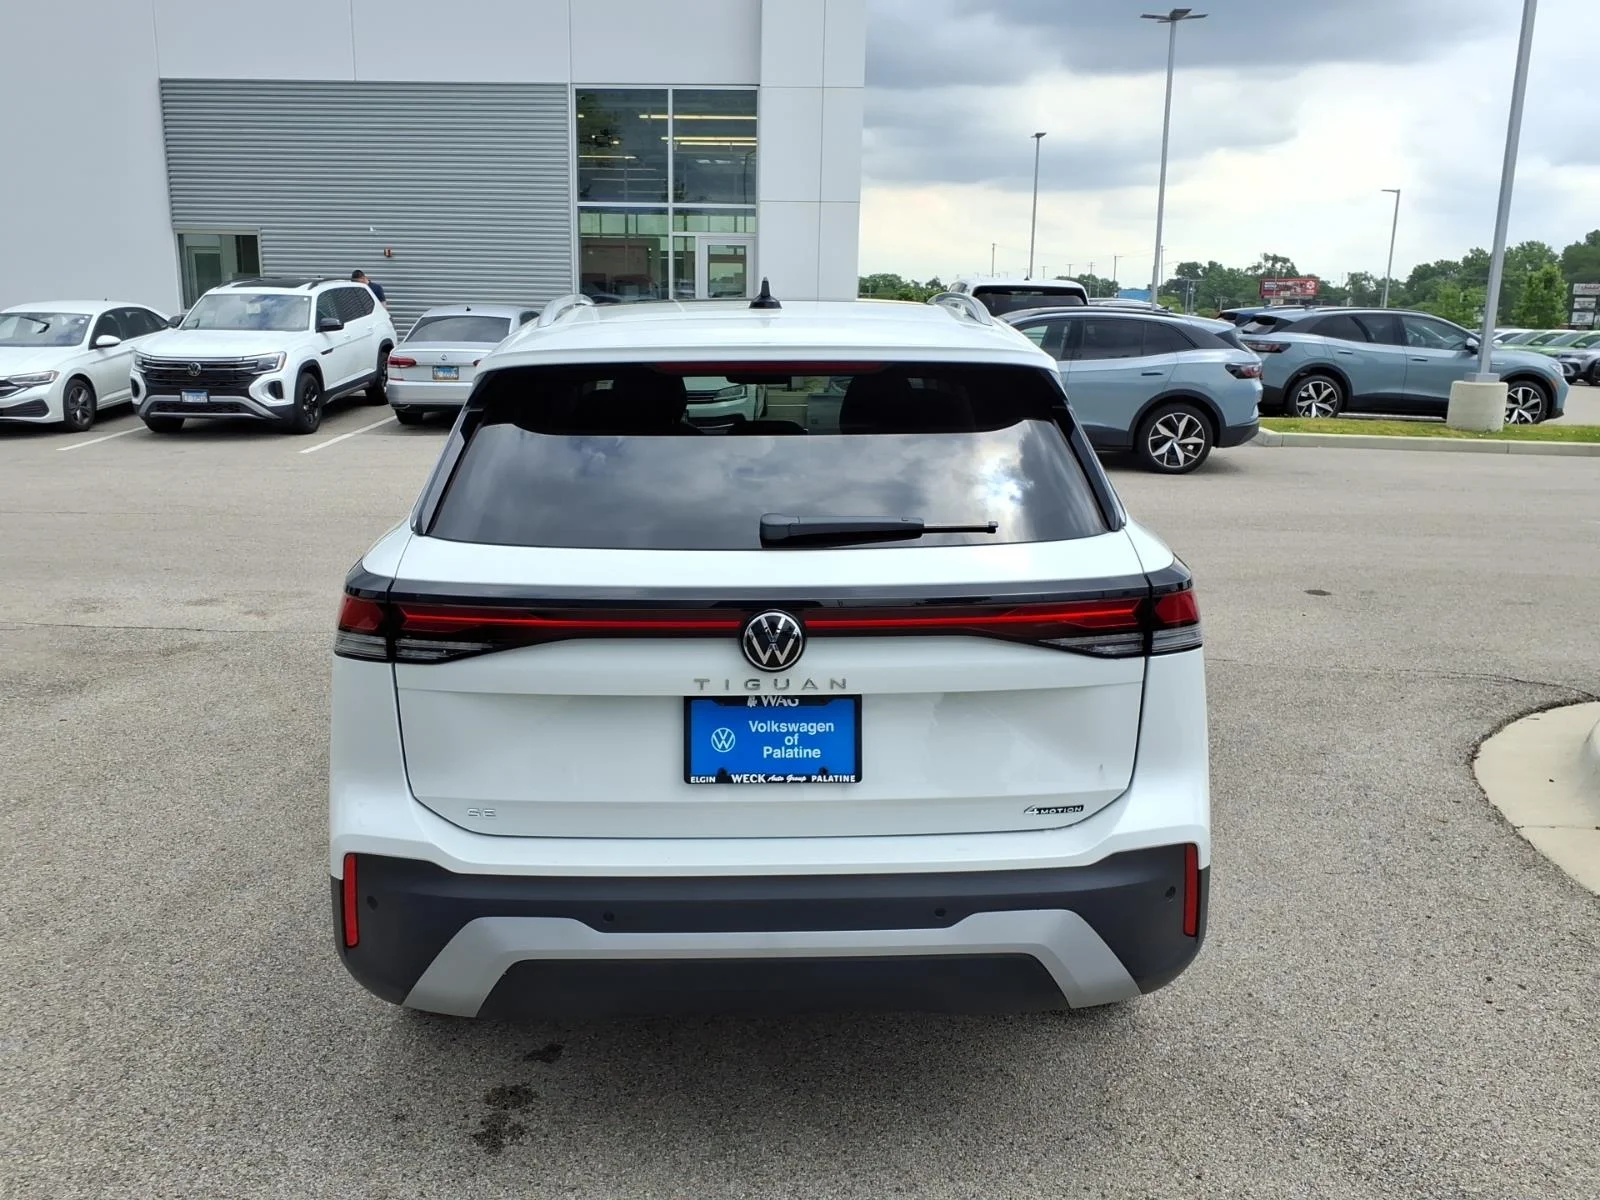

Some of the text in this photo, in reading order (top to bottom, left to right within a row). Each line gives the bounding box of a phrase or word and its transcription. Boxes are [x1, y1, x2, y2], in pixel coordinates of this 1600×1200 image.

[693, 678, 847, 690] TIGUAN
[749, 720, 834, 735] Volkswagen
[784, 733, 799, 745] of
[763, 746, 821, 758] Palatine
[730, 774, 766, 783] WECK
[811, 775, 856, 783] PALATINE
[467, 808, 496, 817] SE
[1024, 804, 1083, 815] 4MOTION
